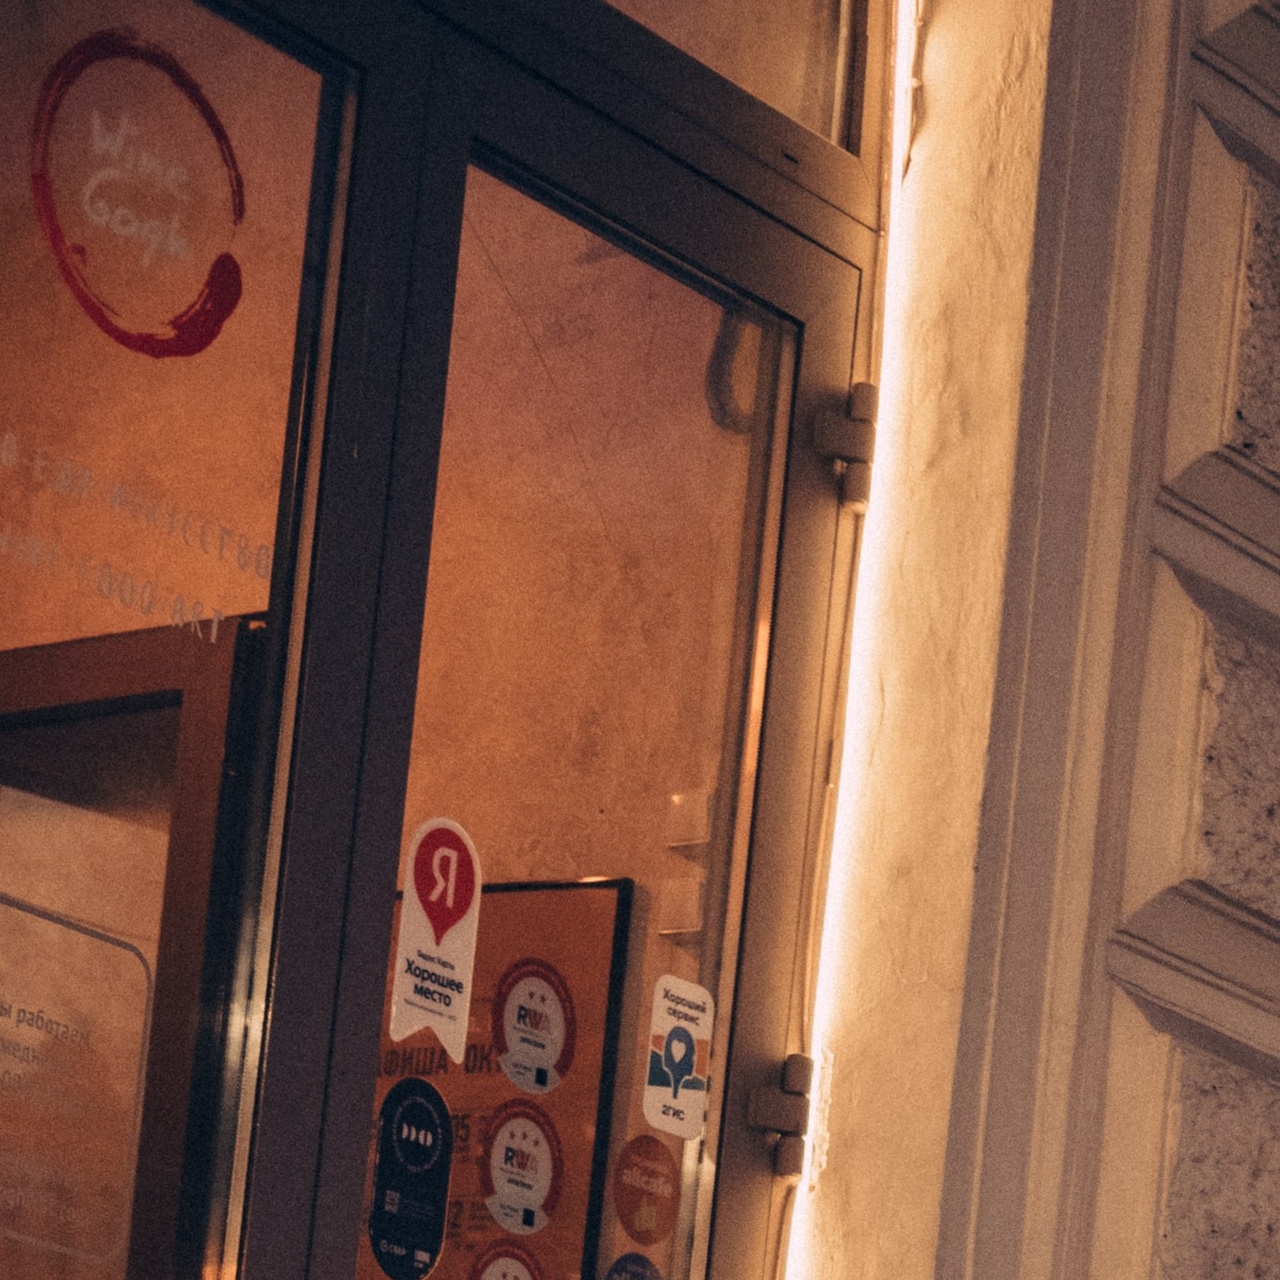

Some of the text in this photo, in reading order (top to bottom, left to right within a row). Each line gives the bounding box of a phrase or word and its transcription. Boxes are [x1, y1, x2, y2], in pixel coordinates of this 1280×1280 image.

[90, 107, 190, 187] Wine
[82, 169, 190, 266] Gogh
[171, 591, 227, 647] ART
[404, 956, 465, 994] Хорошее
[413, 983, 453, 1007] место
[662, 987, 708, 1014] Хороший
[0, 1001, 91, 1046] ы работаем
[378, 1046, 448, 1077] ФИША
